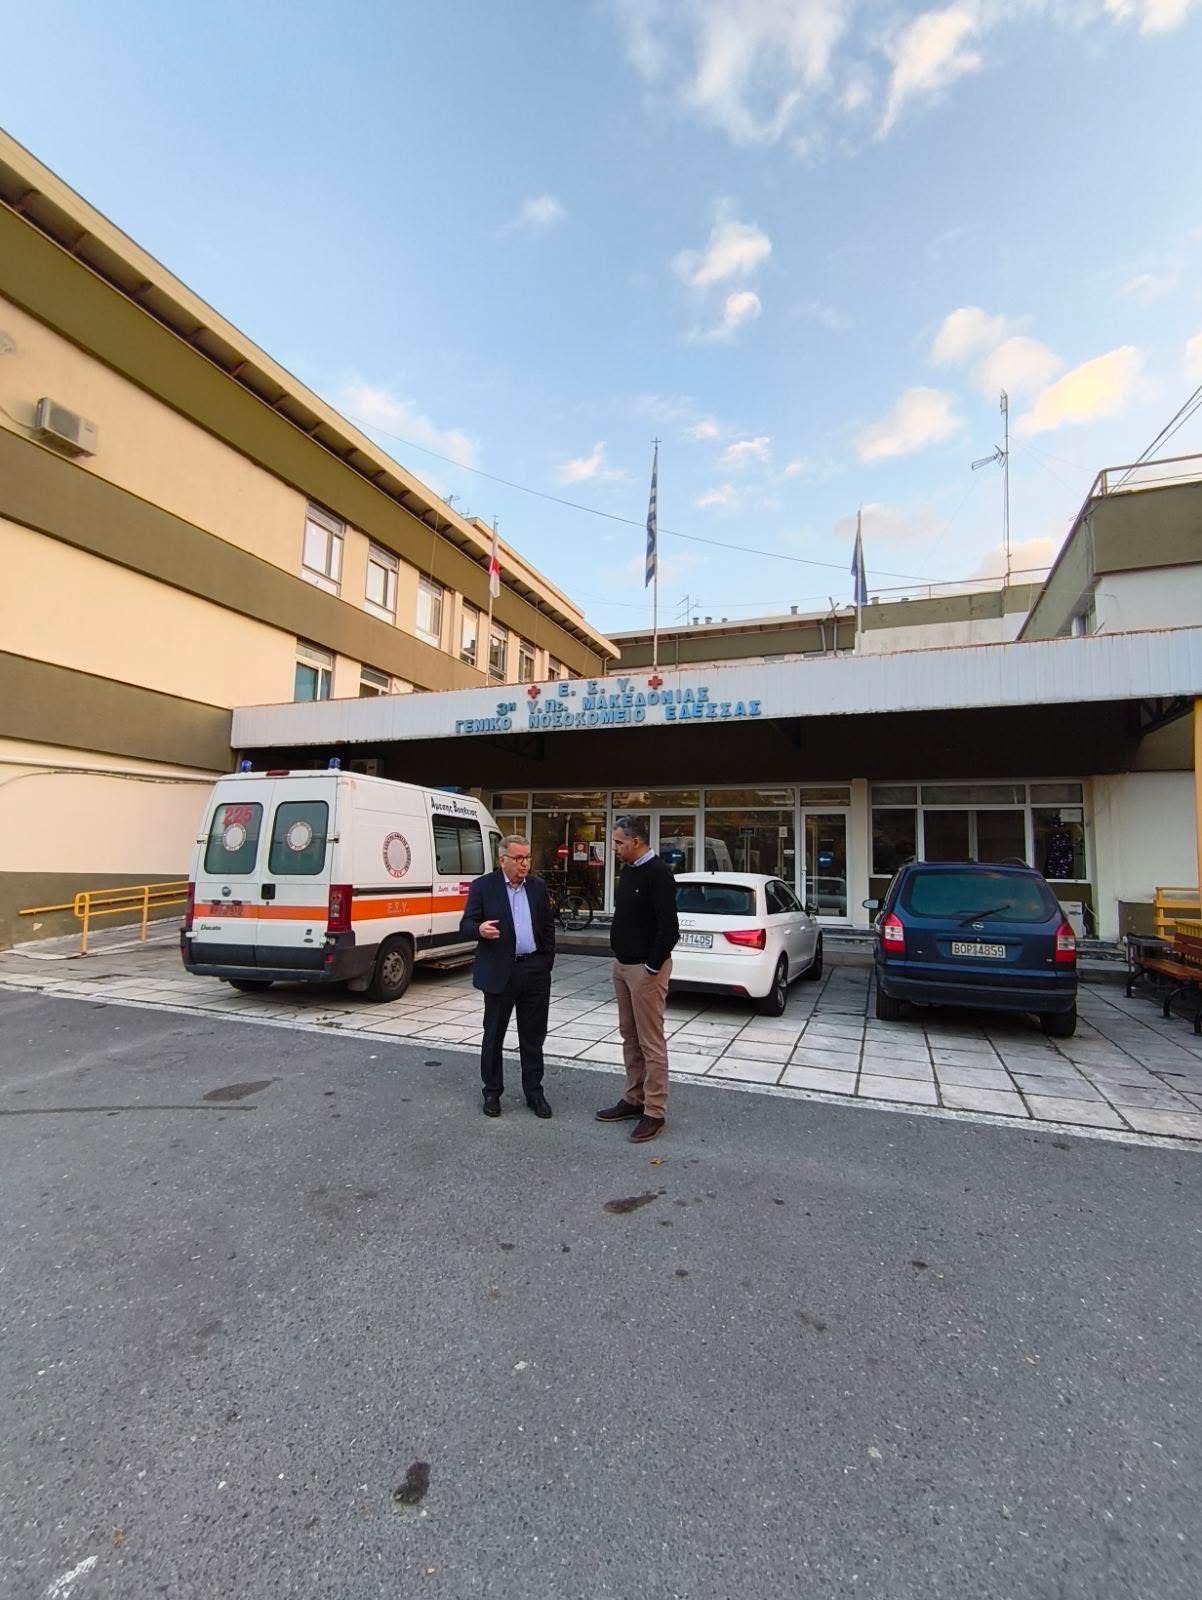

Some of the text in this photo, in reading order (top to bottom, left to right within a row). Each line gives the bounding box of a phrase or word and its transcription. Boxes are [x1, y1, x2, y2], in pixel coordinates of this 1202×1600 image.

[583, 687, 709, 711] ΜΑΚΕΔΟΝΙΑΣ
[455, 700, 762, 734] ΓΕΝΙΚΟ ΝΟΣΟΚΟΜΕΙΟ ΕΔΕΣΣΑΣ
